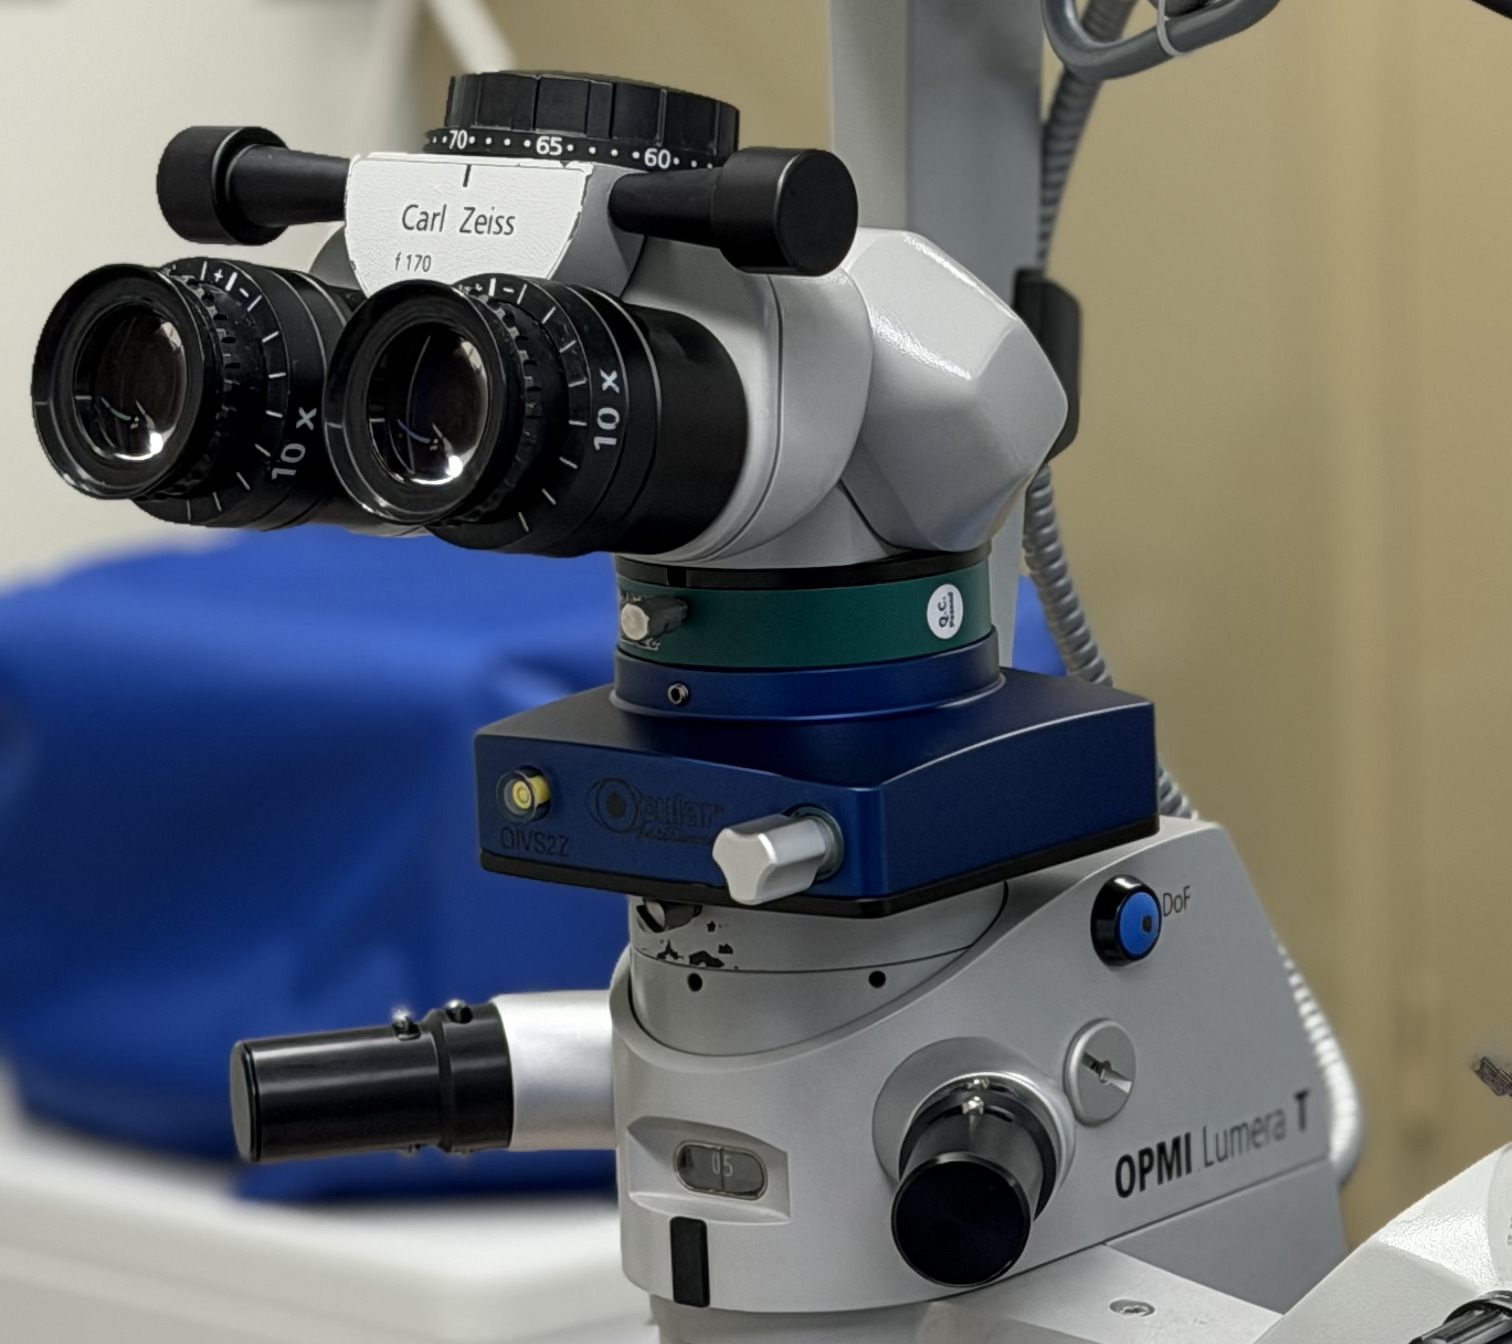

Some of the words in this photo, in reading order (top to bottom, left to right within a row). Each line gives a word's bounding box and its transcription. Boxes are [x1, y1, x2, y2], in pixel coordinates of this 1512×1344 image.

[449, 129, 468, 150] 70
[535, 135, 563, 156] 65
[644, 148, 671, 170] 60
[401, 203, 447, 233] Carl
[459, 205, 517, 236] Zeiss
[1163, 885, 1192, 917] DoF
[1115, 1131, 1193, 1199] OPMI
[1202, 1108, 1287, 1169] Lumera
[1293, 1088, 1311, 1132] T
